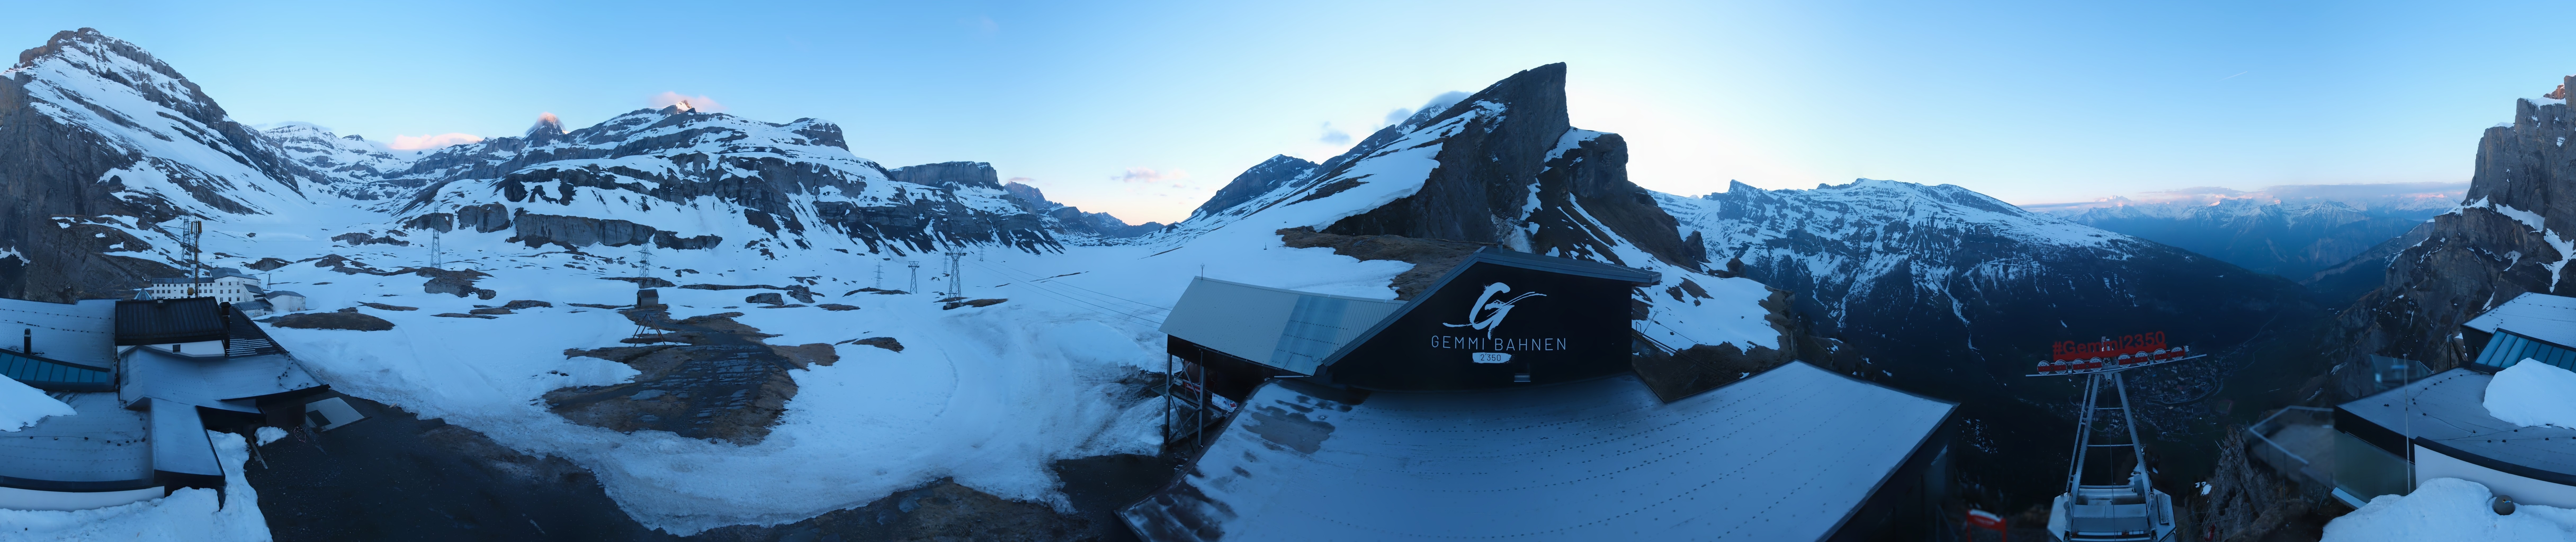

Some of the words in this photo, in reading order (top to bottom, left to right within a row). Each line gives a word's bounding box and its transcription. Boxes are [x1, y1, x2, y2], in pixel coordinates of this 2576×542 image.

[1431, 335, 1484, 350] GEMMI
[1495, 338, 1566, 351] BAHNEN
[2053, 331, 2165, 355] #Gemmi2350
[1480, 353, 1501, 361] 2'350
